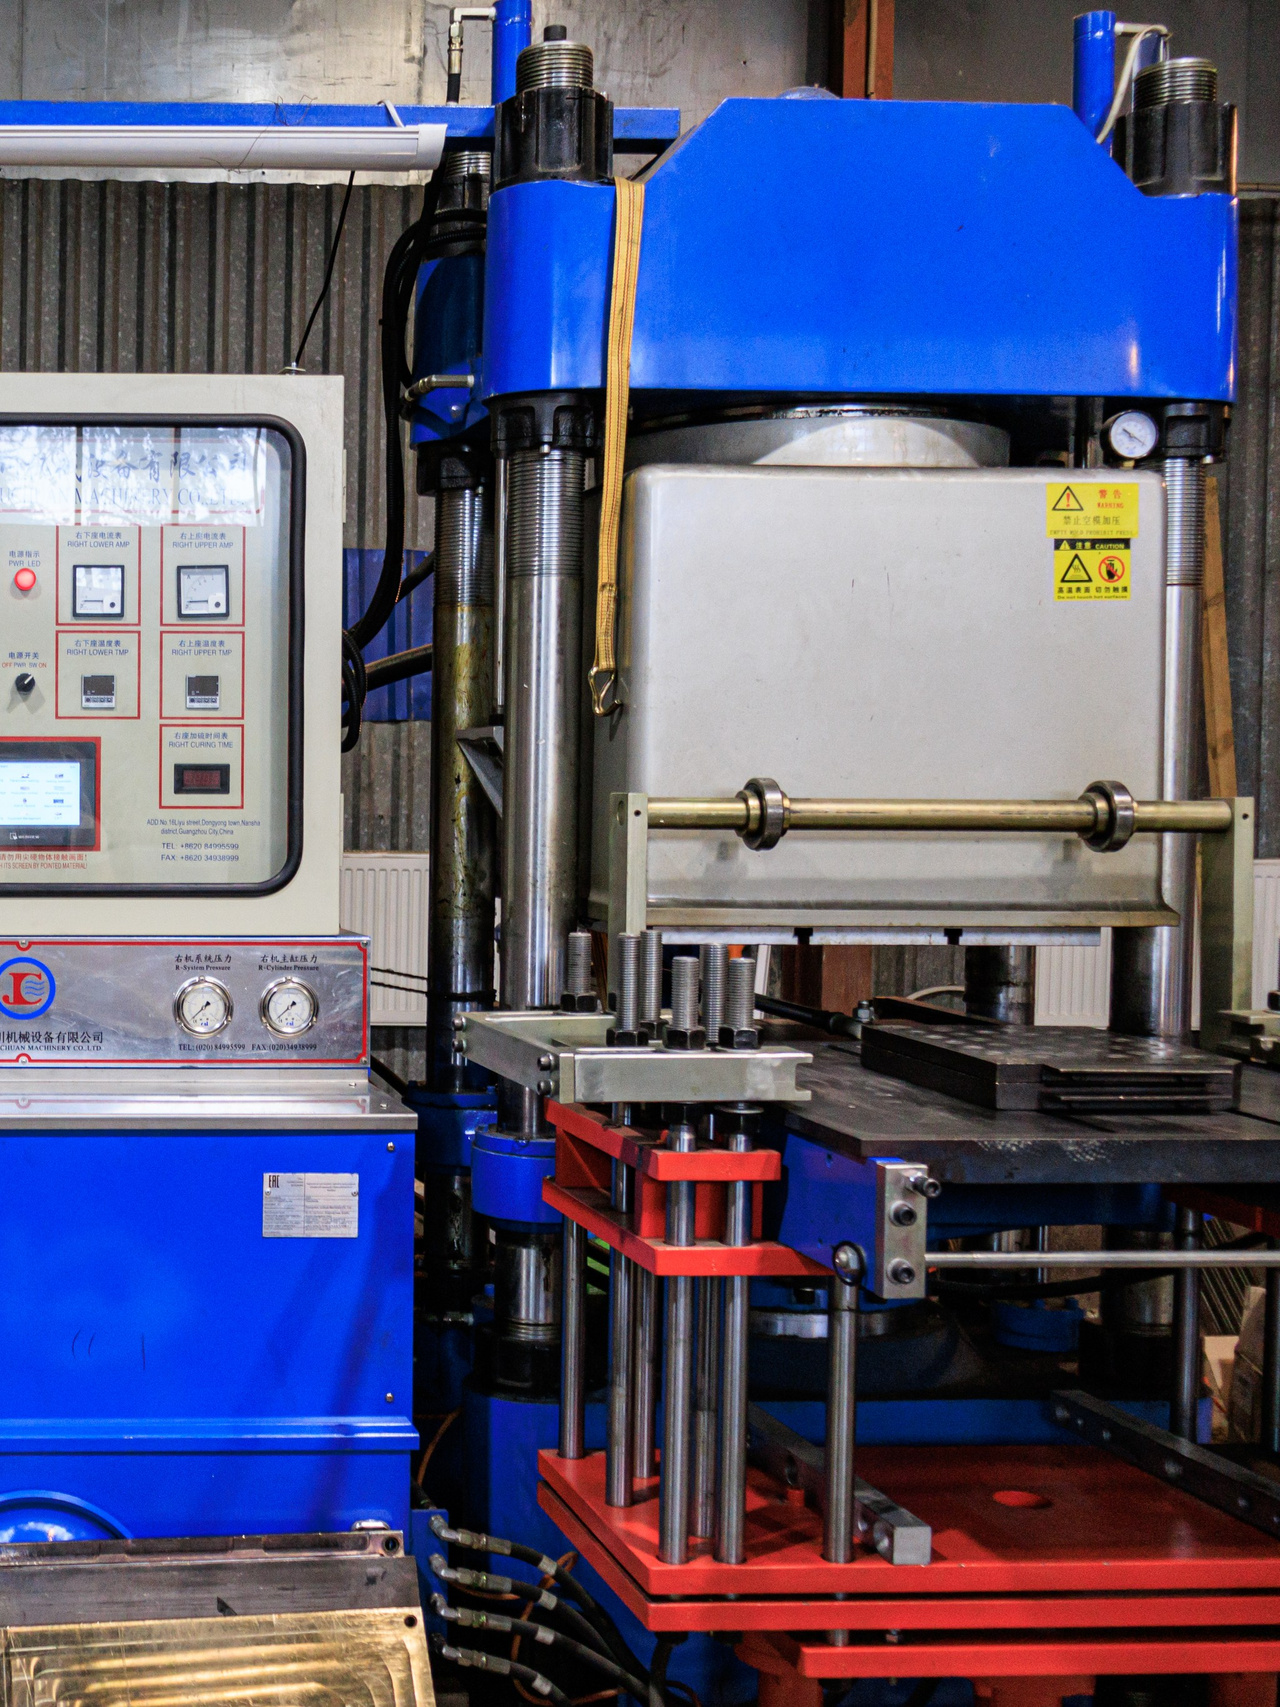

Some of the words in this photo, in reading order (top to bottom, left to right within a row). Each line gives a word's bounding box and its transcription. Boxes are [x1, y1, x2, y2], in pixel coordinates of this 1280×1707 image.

[1098, 489, 1123, 499] 警告
[1063, 515, 1121, 525] 禁止空模加压
[172, 541, 193, 549] RIGHT
[194, 541, 218, 549] UPPER
[219, 541, 234, 549] AMP
[8, 651, 40, 660] 电源开关
[12, 862, 32, 870] SCREEN
[32, 862, 40, 870] BY
[40, 862, 61, 870] POINTED
[174, 953, 232, 964] 右机系统压力
[260, 953, 318, 964] 右机主缸压力
